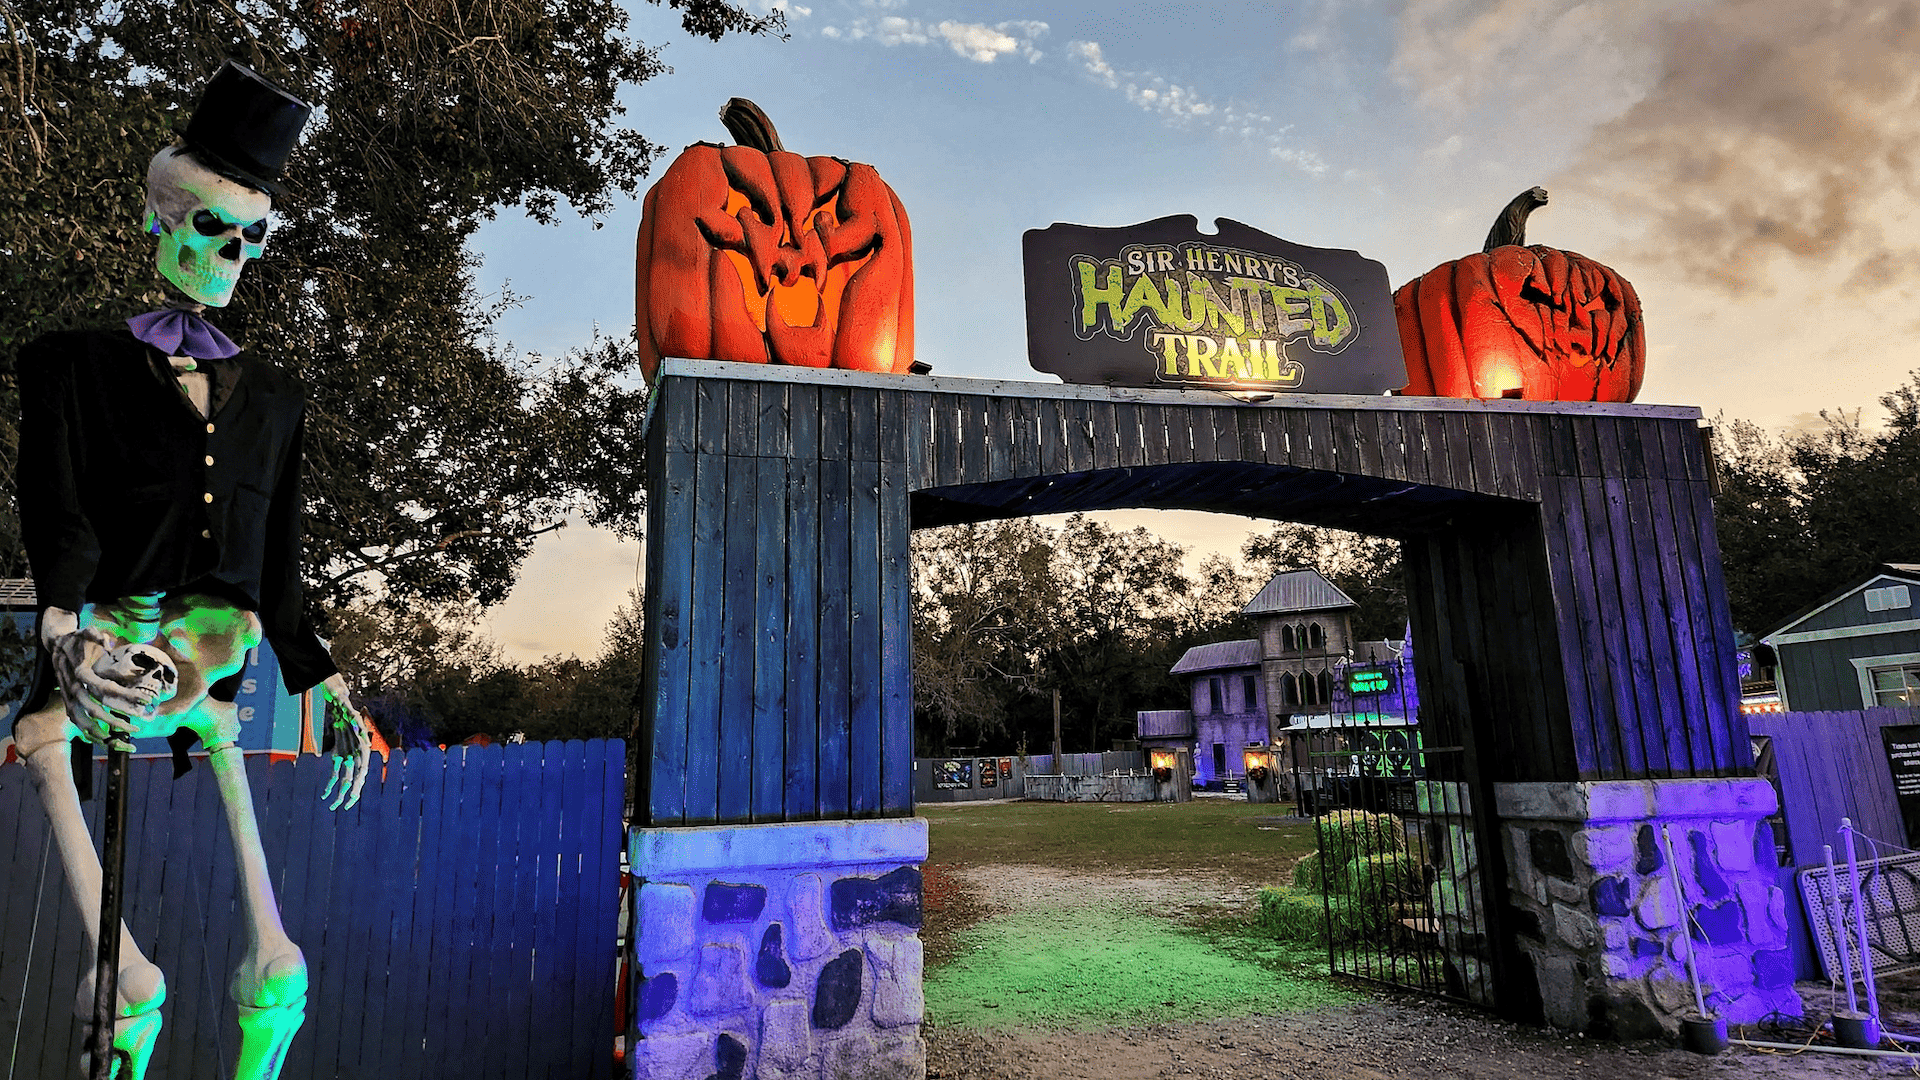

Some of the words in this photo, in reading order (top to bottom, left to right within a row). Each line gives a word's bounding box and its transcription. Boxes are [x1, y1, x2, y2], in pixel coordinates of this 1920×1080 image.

[1127, 250, 1176, 276] SIR
[1188, 248, 1301, 287] HENRY'S
[1077, 261, 1352, 347] HAUNTED
[1153, 332, 1297, 381] TRAIL
